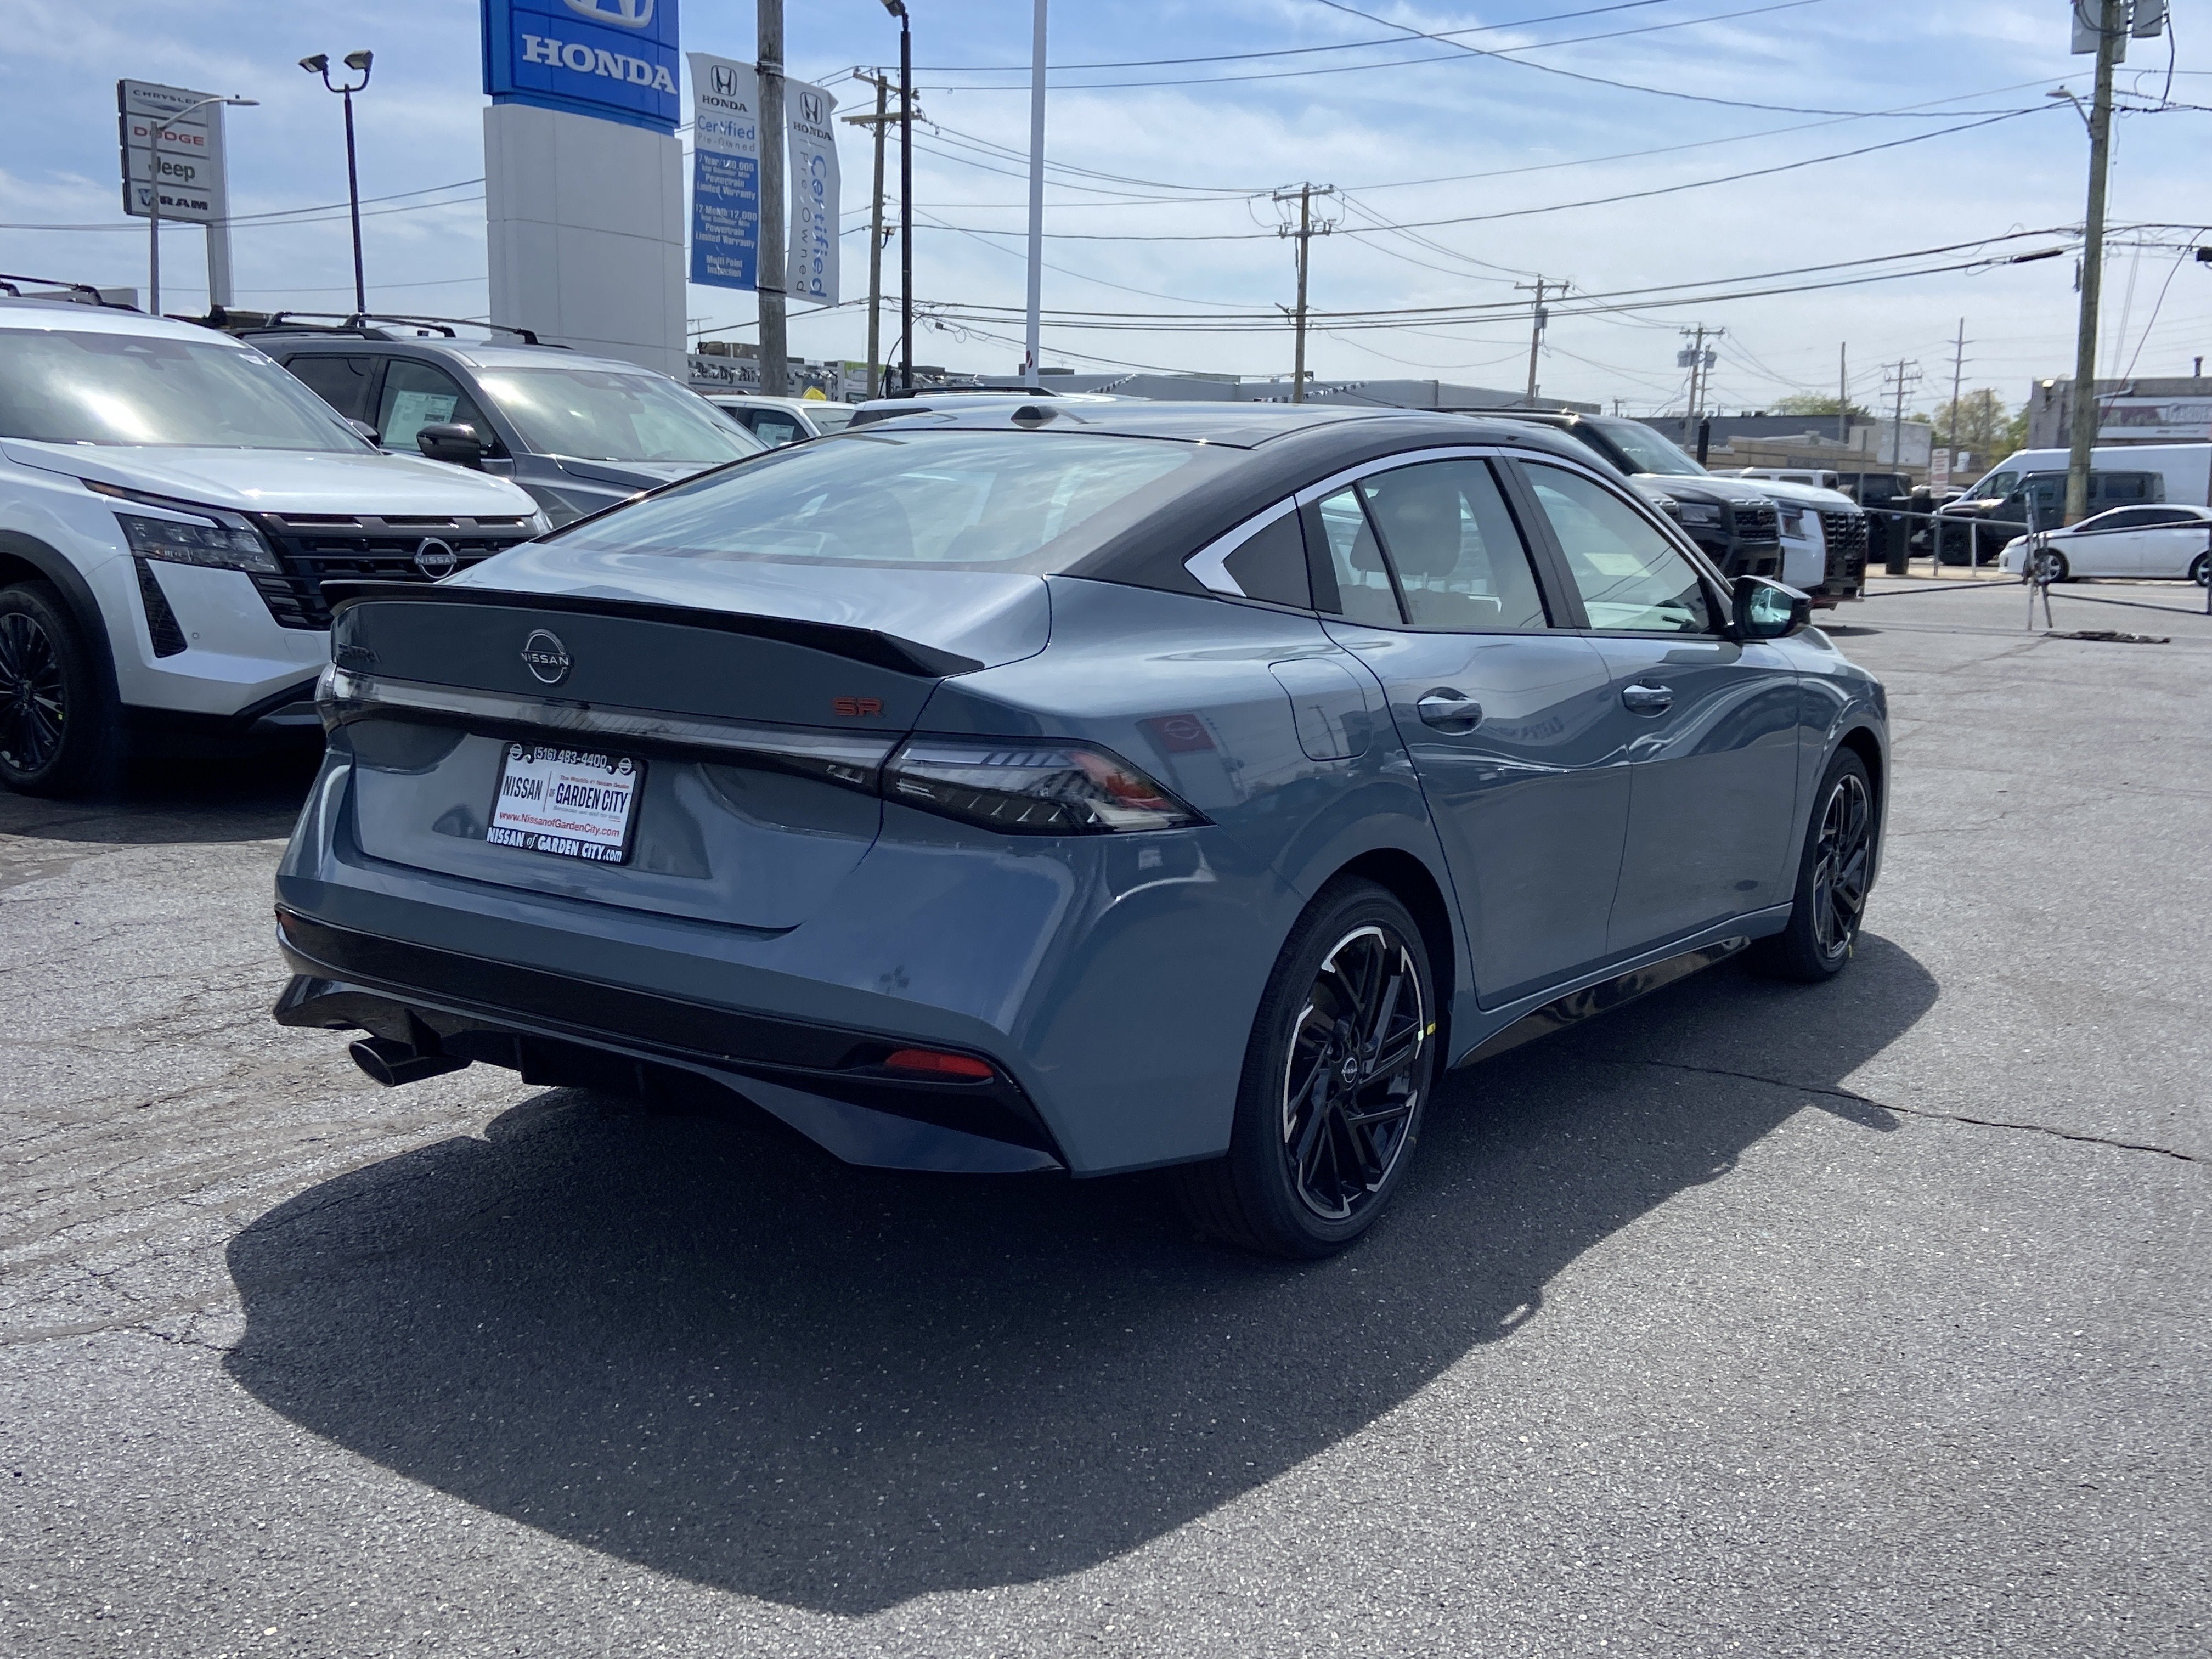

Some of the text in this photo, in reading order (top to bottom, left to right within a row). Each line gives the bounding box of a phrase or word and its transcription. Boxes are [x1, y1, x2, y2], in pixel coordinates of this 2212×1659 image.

[521, 33, 678, 95] HONDA
[702, 94, 748, 112] HONDA
[698, 115, 755, 140] Certified
[793, 121, 833, 142] HONDA
[160, 195, 208, 211] RAM
[810, 155, 828, 297] Certified
[415, 556, 456, 565] NISSAN
[521, 652, 569, 665] NISSAN
[833, 696, 884, 718] SR
[534, 747, 607, 768] (516) 483-4400
[503, 775, 543, 800] NISSAN
[556, 783, 601, 810] GARDEN
[602, 790, 628, 813] CITY
[499, 811, 620, 837] www.NissanofGardenCity.com
[487, 827, 622, 862] NISSAN of GARDEN CITY.com
